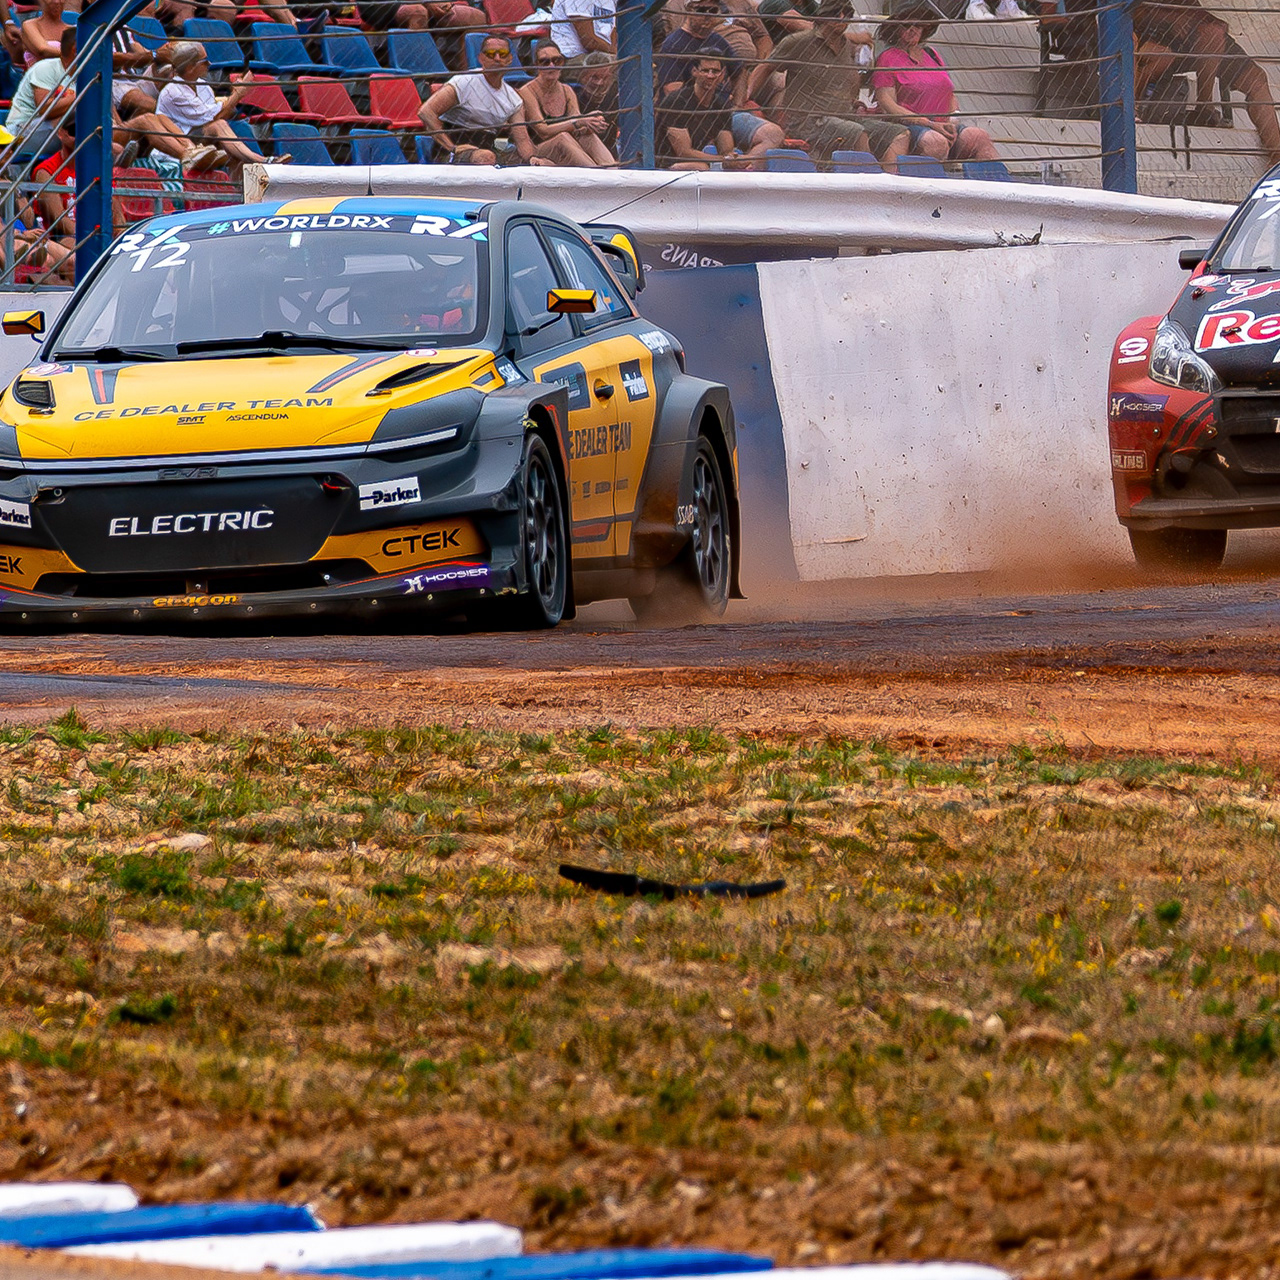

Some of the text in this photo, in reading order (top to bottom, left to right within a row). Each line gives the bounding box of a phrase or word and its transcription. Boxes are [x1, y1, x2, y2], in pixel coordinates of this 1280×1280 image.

[206, 214, 395, 235] #WORLDRX
[410, 214, 488, 242] RX
[110, 224, 190, 256] RX
[129, 242, 192, 273] 12
[74, 397, 334, 422] CE DEALER TEAM
[226, 413, 290, 422] ASCENDUM
[1122, 402, 1164, 412] HOOSIER
[177, 415, 207, 425] SMT
[575, 425, 608, 460] DEALER
[609, 421, 632, 453] TEAM
[371, 487, 419, 505] Parker
[108, 509, 275, 537] ELECTRIC
[381, 528, 462, 557] CTEK
[425, 567, 488, 583] HOOSIER
